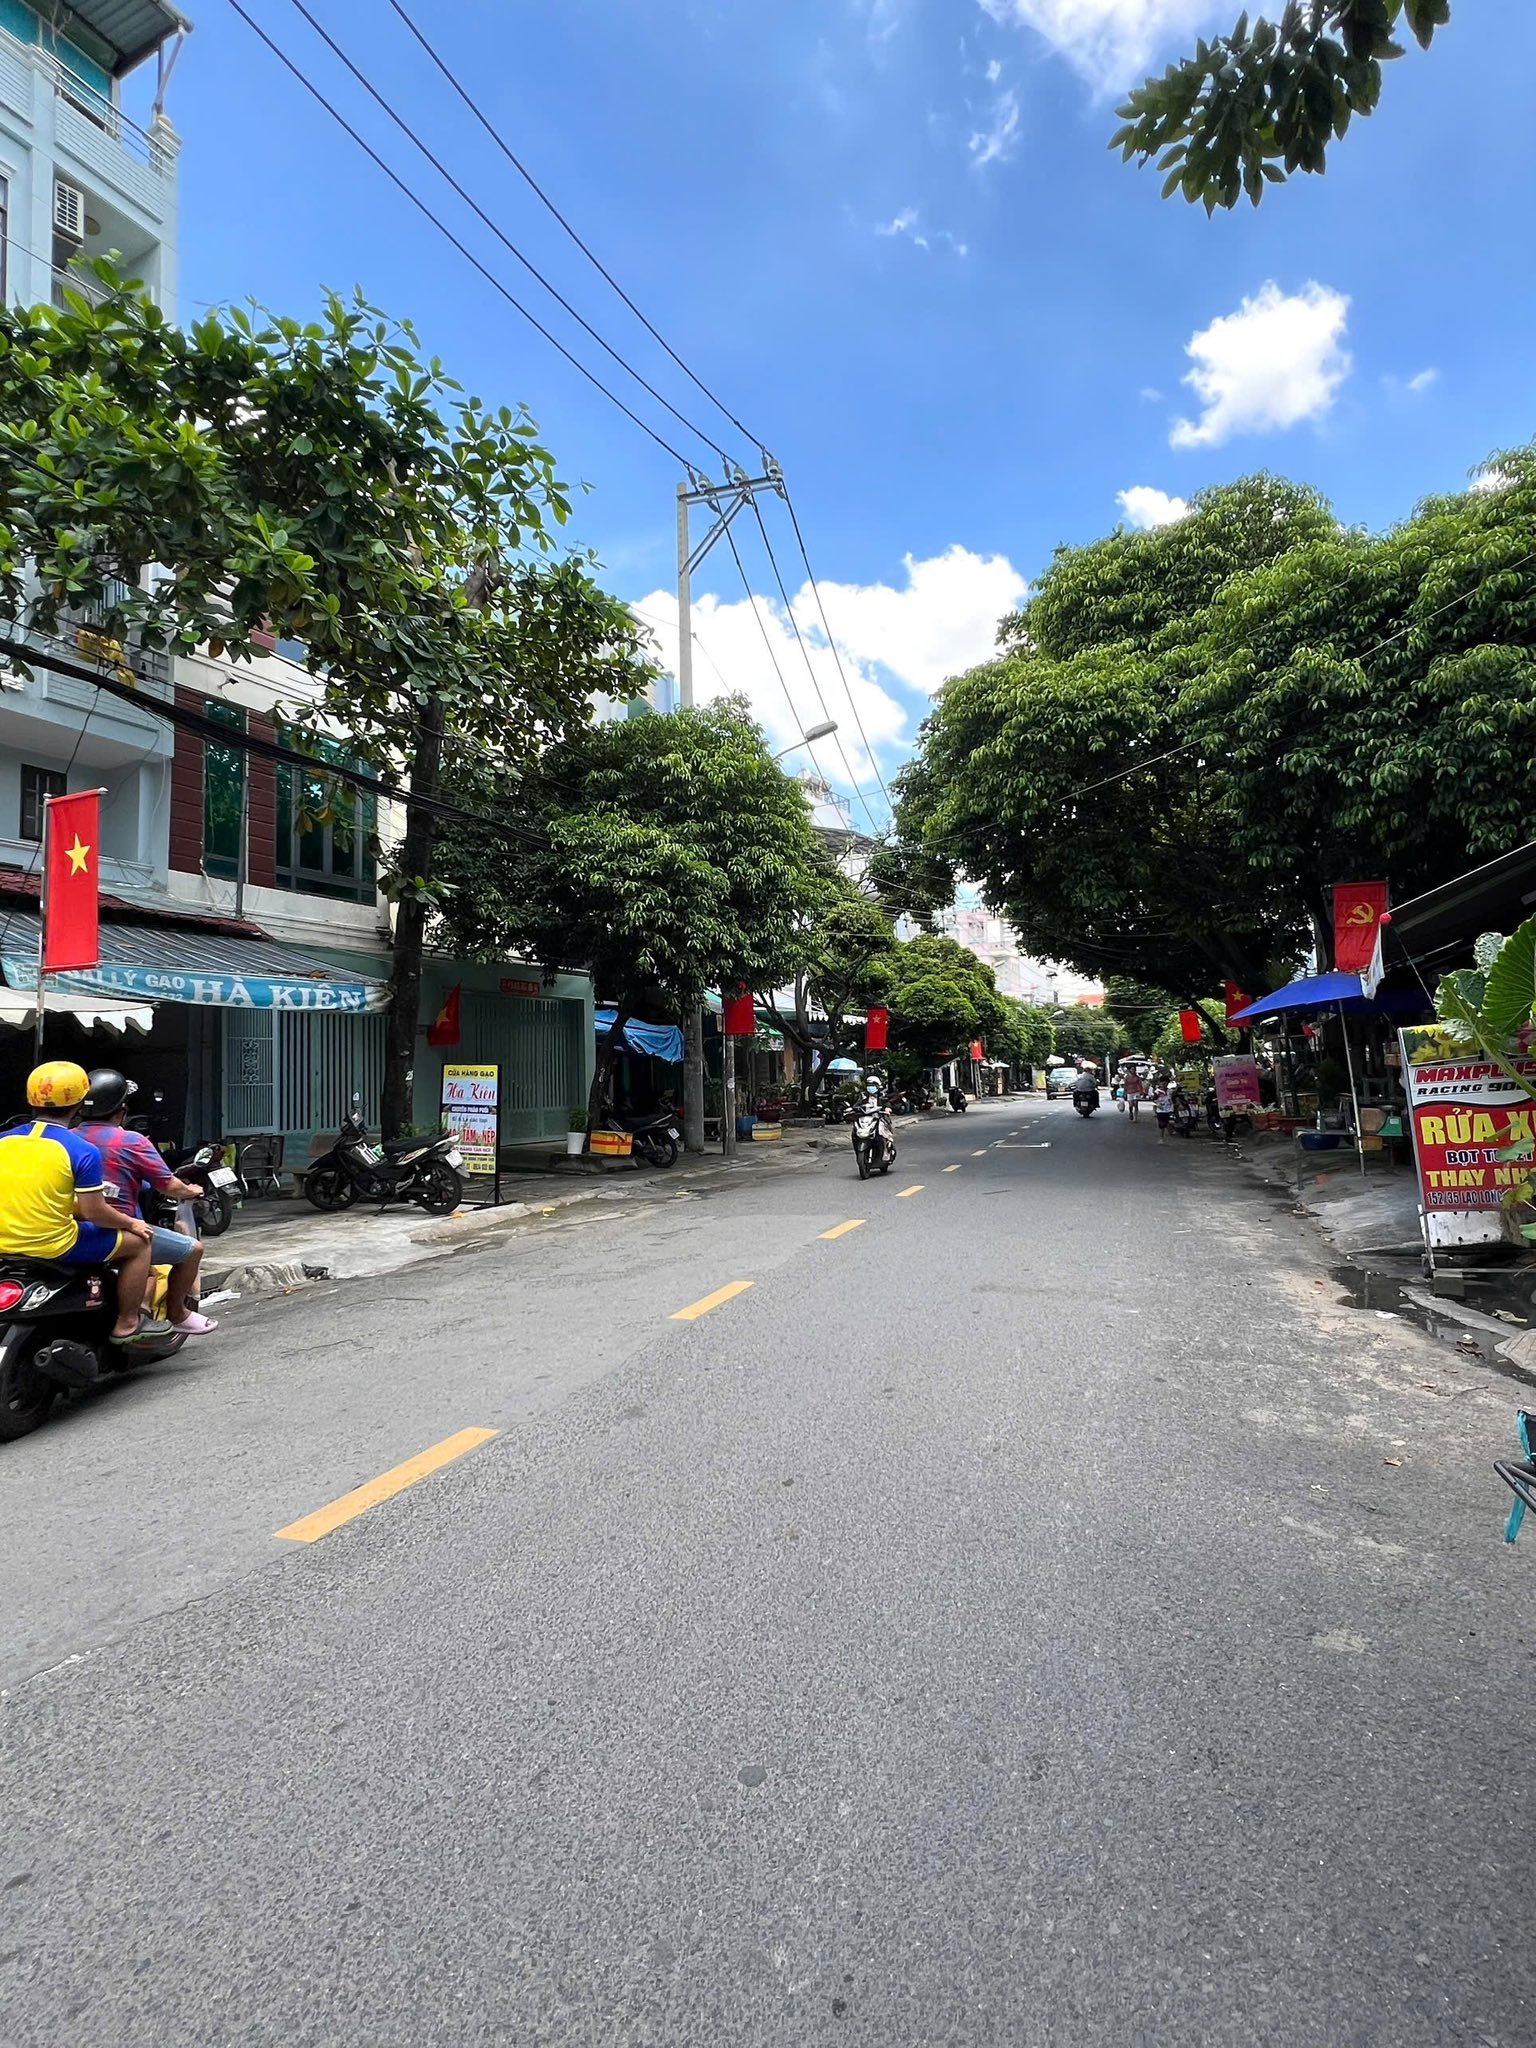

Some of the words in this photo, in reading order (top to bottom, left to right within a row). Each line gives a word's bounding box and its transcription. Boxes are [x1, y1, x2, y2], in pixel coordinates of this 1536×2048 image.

[190, 976, 255, 1008] HÀ
[269, 983, 361, 1012] KIÊN
[1417, 1084, 1482, 1095] RACING
[1420, 1108, 1496, 1145] RỬA
[1506, 1111, 1536, 1142] X
[1445, 1150, 1479, 1166] BỌT
[1425, 1169, 1485, 1187] THAY
[1427, 1192, 1459, 1208] 152/35
